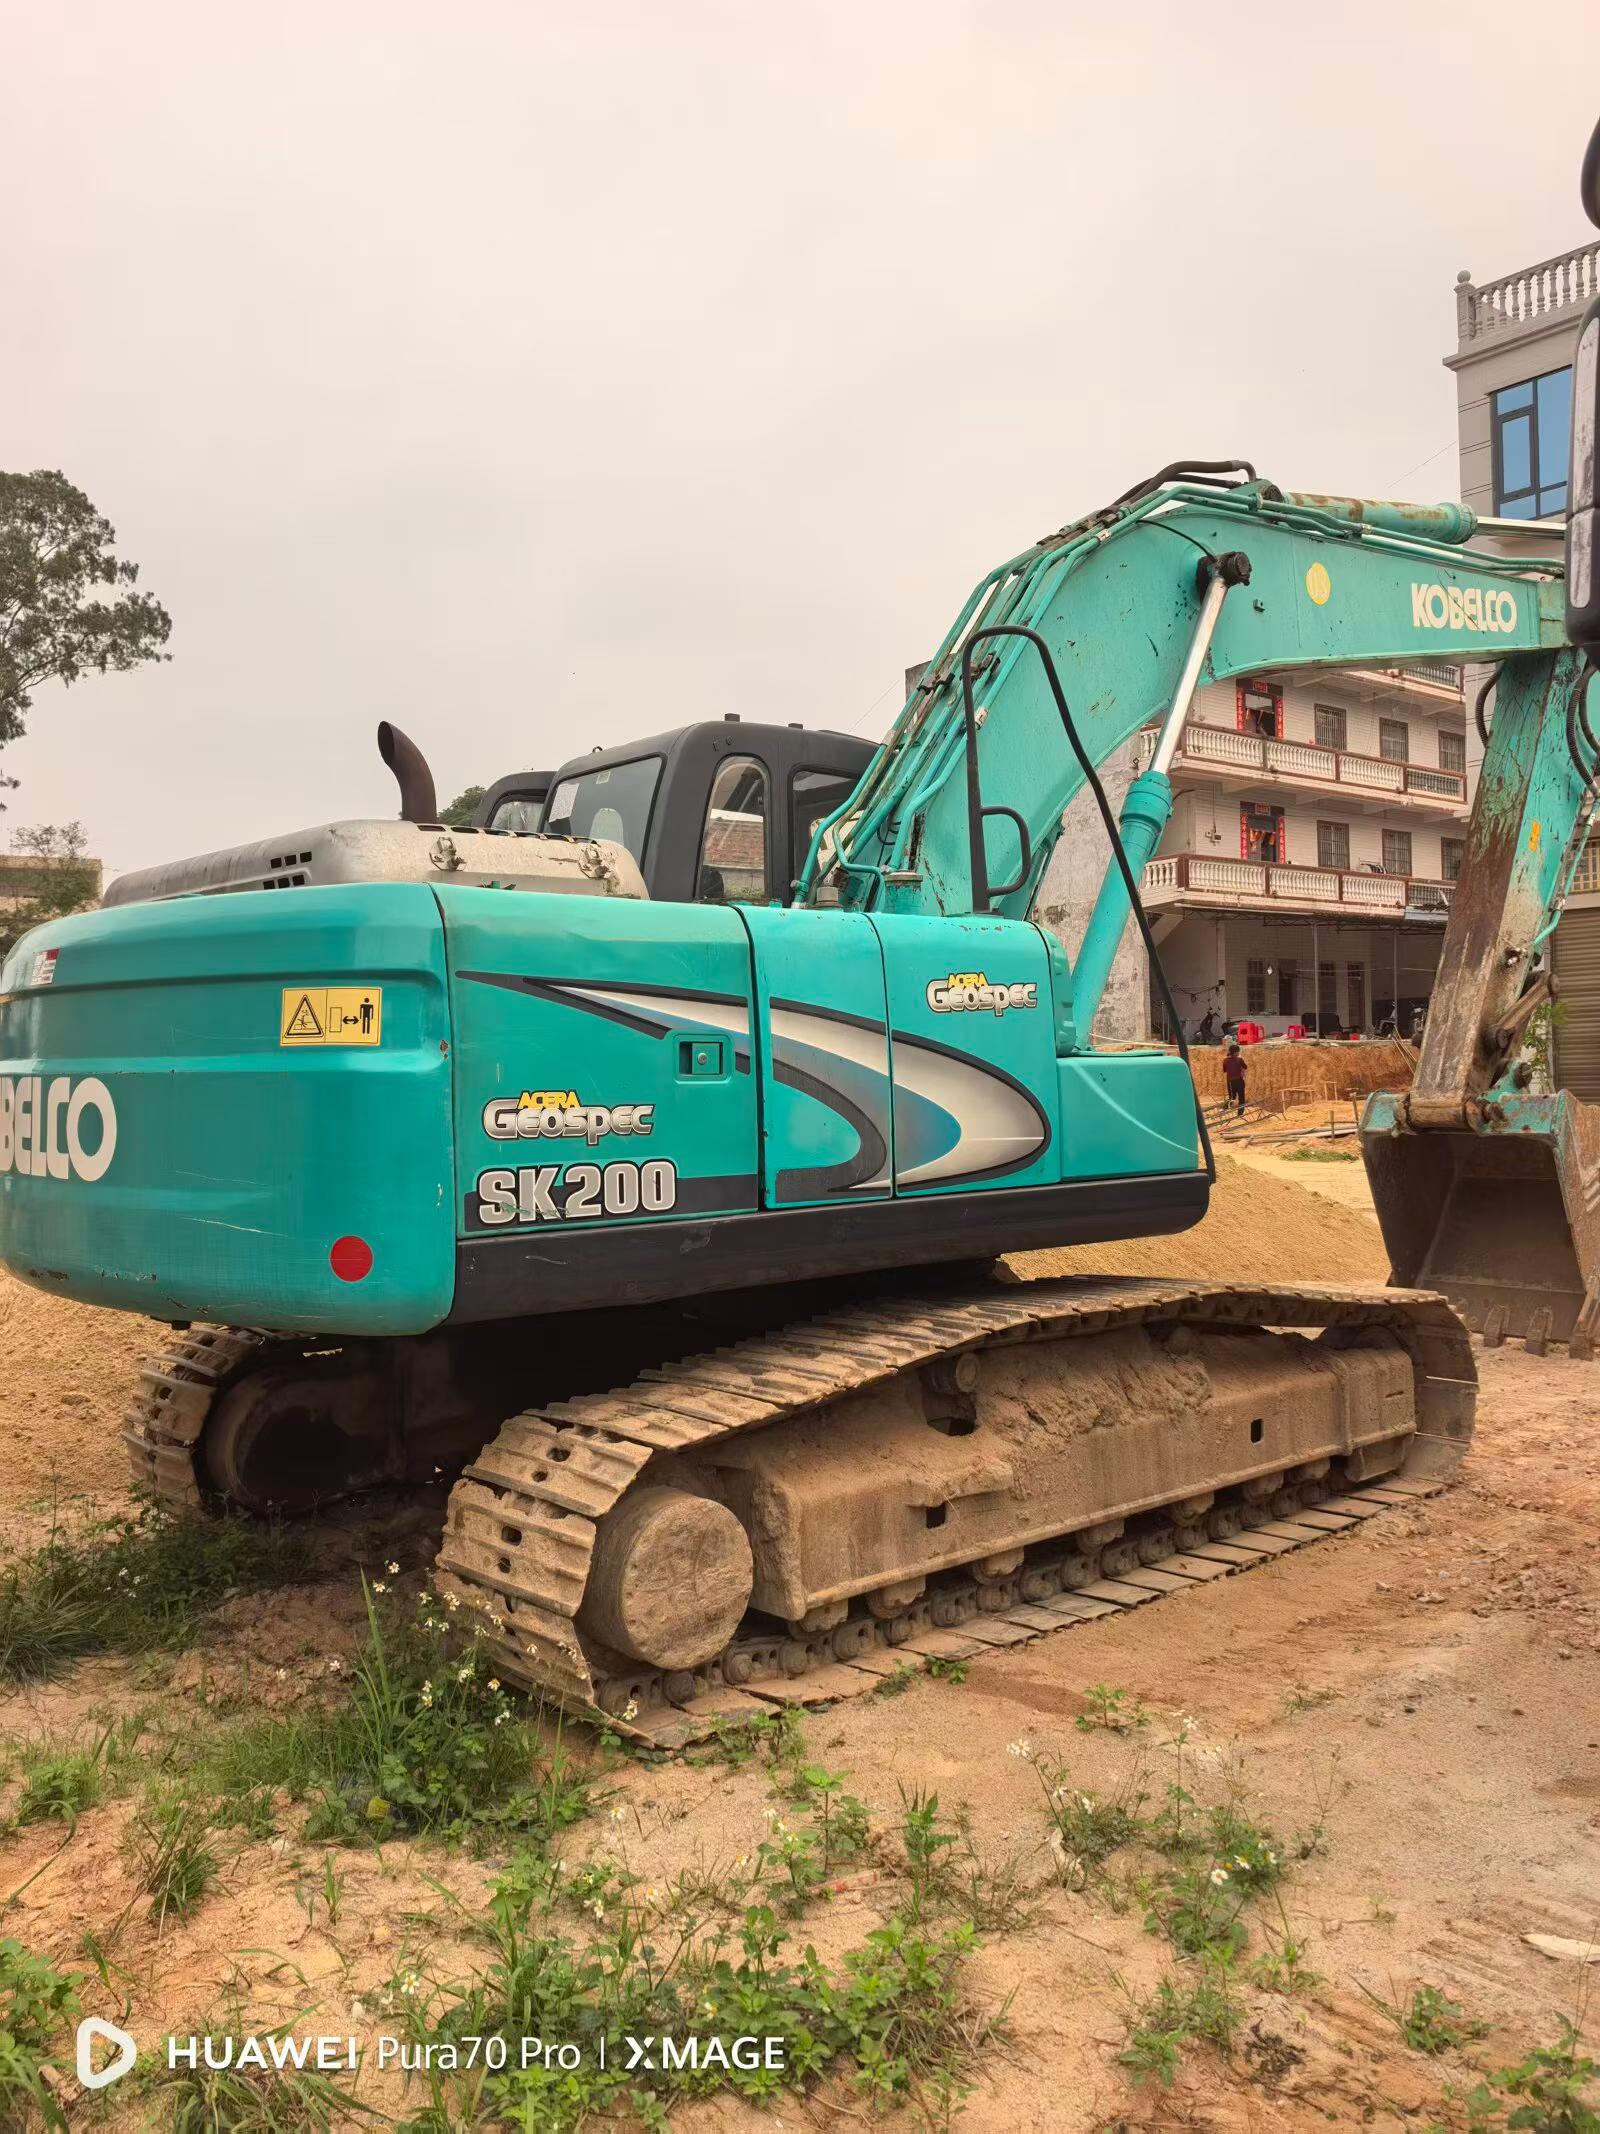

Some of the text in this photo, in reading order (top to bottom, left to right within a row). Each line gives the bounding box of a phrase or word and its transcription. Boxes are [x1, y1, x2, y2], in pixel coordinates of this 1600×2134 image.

[1411, 583, 1517, 633] KOBELCO
[517, 1091, 581, 1110] ACERA
[478, 1160, 677, 1225] SK200
